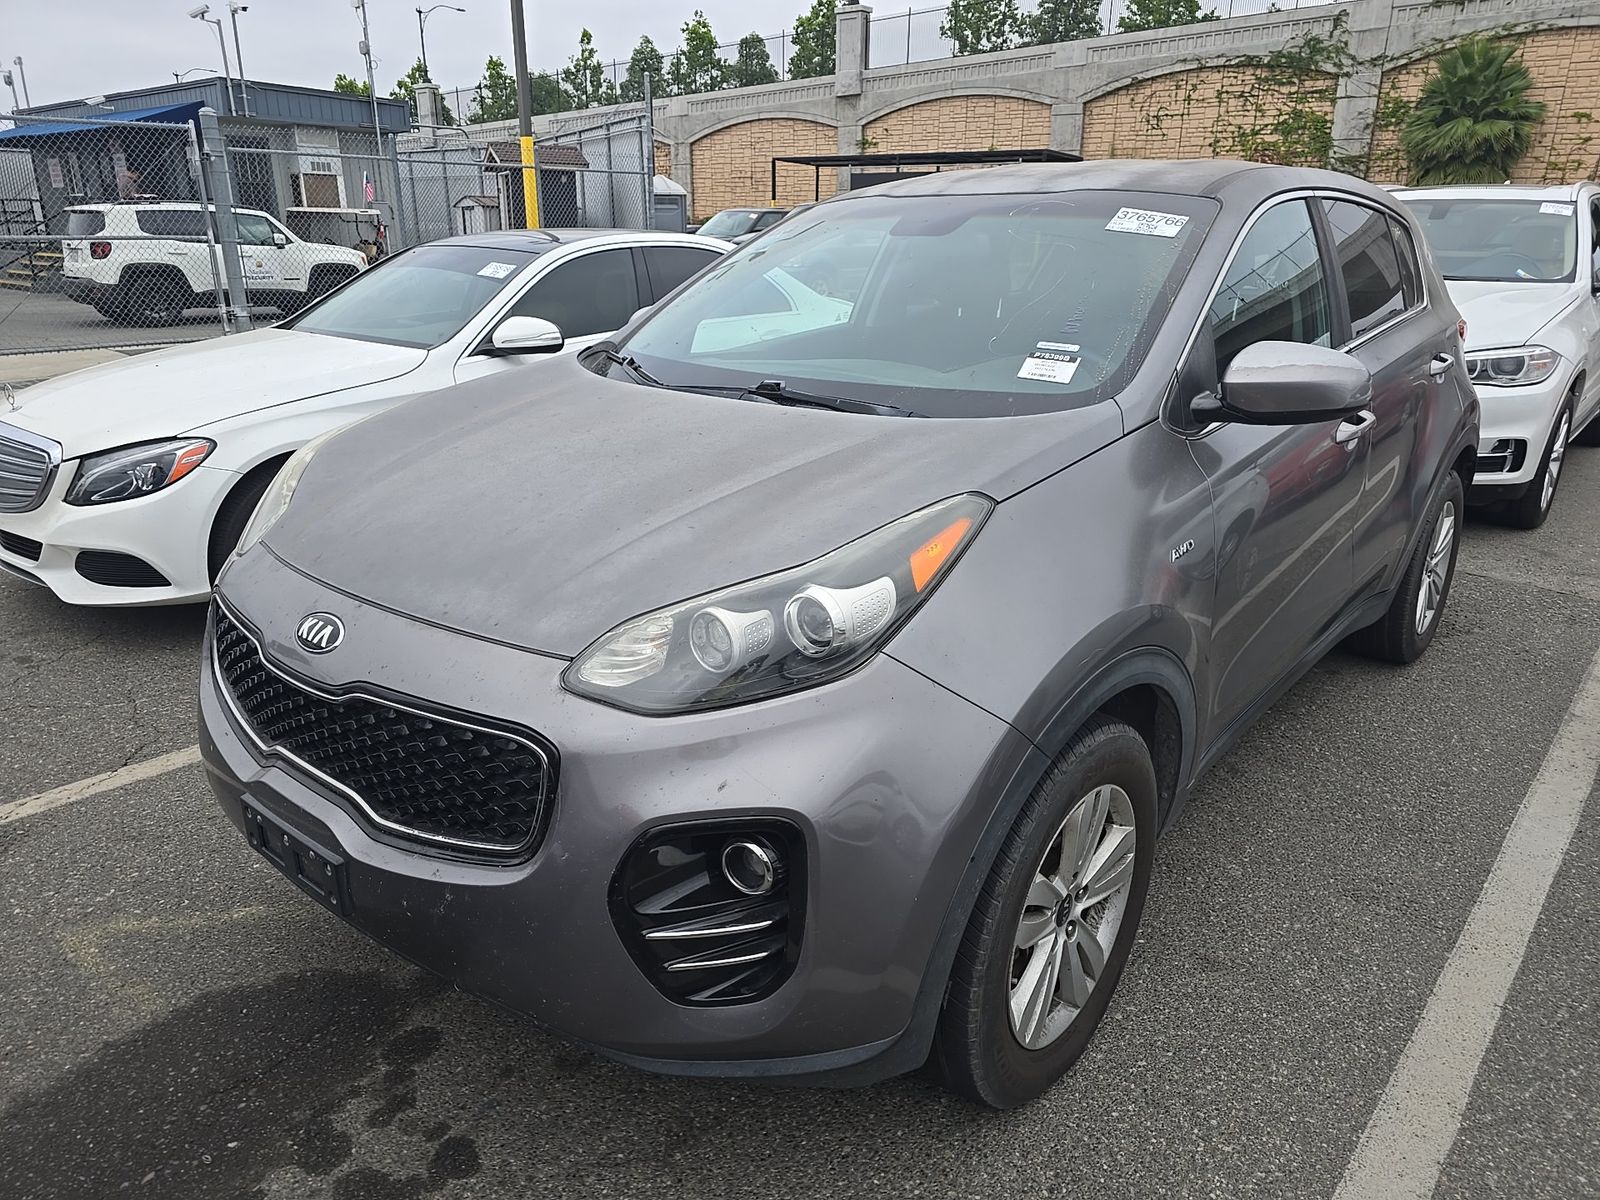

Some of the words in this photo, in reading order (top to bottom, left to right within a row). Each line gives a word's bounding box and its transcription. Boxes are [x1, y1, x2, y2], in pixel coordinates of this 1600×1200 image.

[1117, 210, 1186, 227] 3765766
[1171, 539, 1195, 563] AWD
[297, 617, 334, 648] KIA
